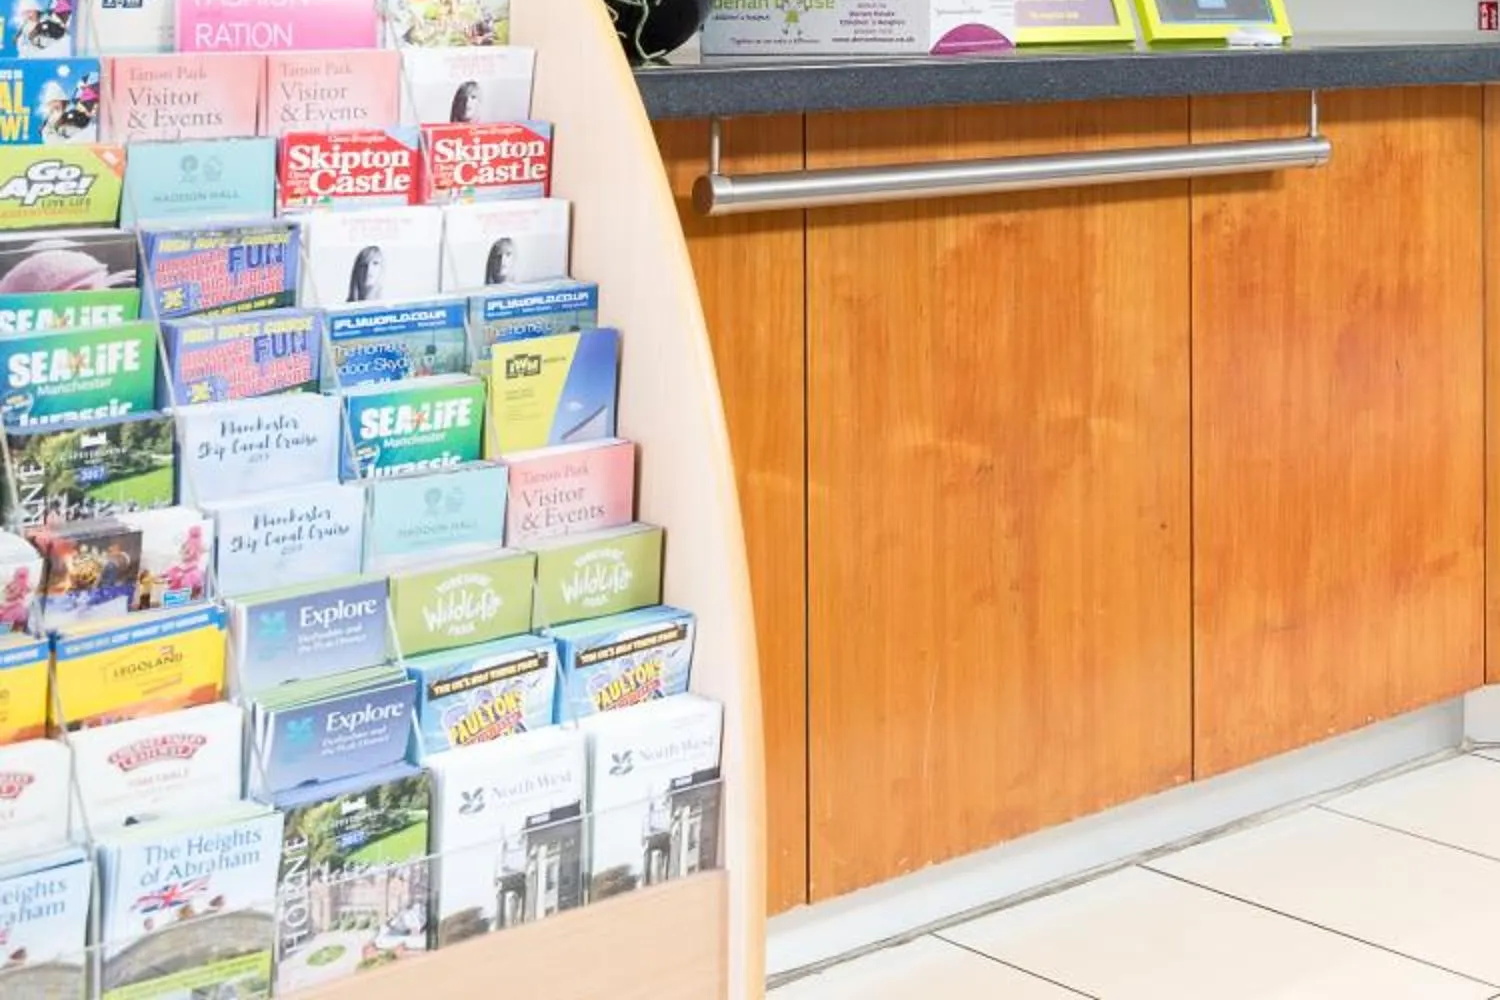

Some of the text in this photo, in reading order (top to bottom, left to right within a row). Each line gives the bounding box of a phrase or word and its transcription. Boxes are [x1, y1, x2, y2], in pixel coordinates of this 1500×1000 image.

[195, 23, 293, 48] RATION
[128, 87, 201, 107] Visitor
[279, 82, 348, 102] Visitor
[127, 109, 223, 130] & Events
[280, 104, 367, 123] & Events
[288, 145, 409, 172] Skipton
[434, 138, 545, 165] Skipton
[27, 159, 82, 183] Go
[308, 169, 411, 195] Castle
[453, 158, 548, 185] Castle
[0, 173, 98, 207] Ape!
[229, 242, 284, 273] FUN
[253, 331, 307, 362] FUN
[8, 350, 73, 387] SEA
[37, 377, 112, 396] Manchester
[360, 405, 417, 441] SEA
[383, 431, 447, 449] Manchester
[521, 486, 584, 506] Visitor
[521, 504, 605, 530] & Events
[300, 599, 376, 628] Explore
[326, 702, 405, 732] Explore
[145, 828, 262, 865] The Heights
[140, 851, 261, 887] of Abraham
[2, 880, 67, 905] eights
